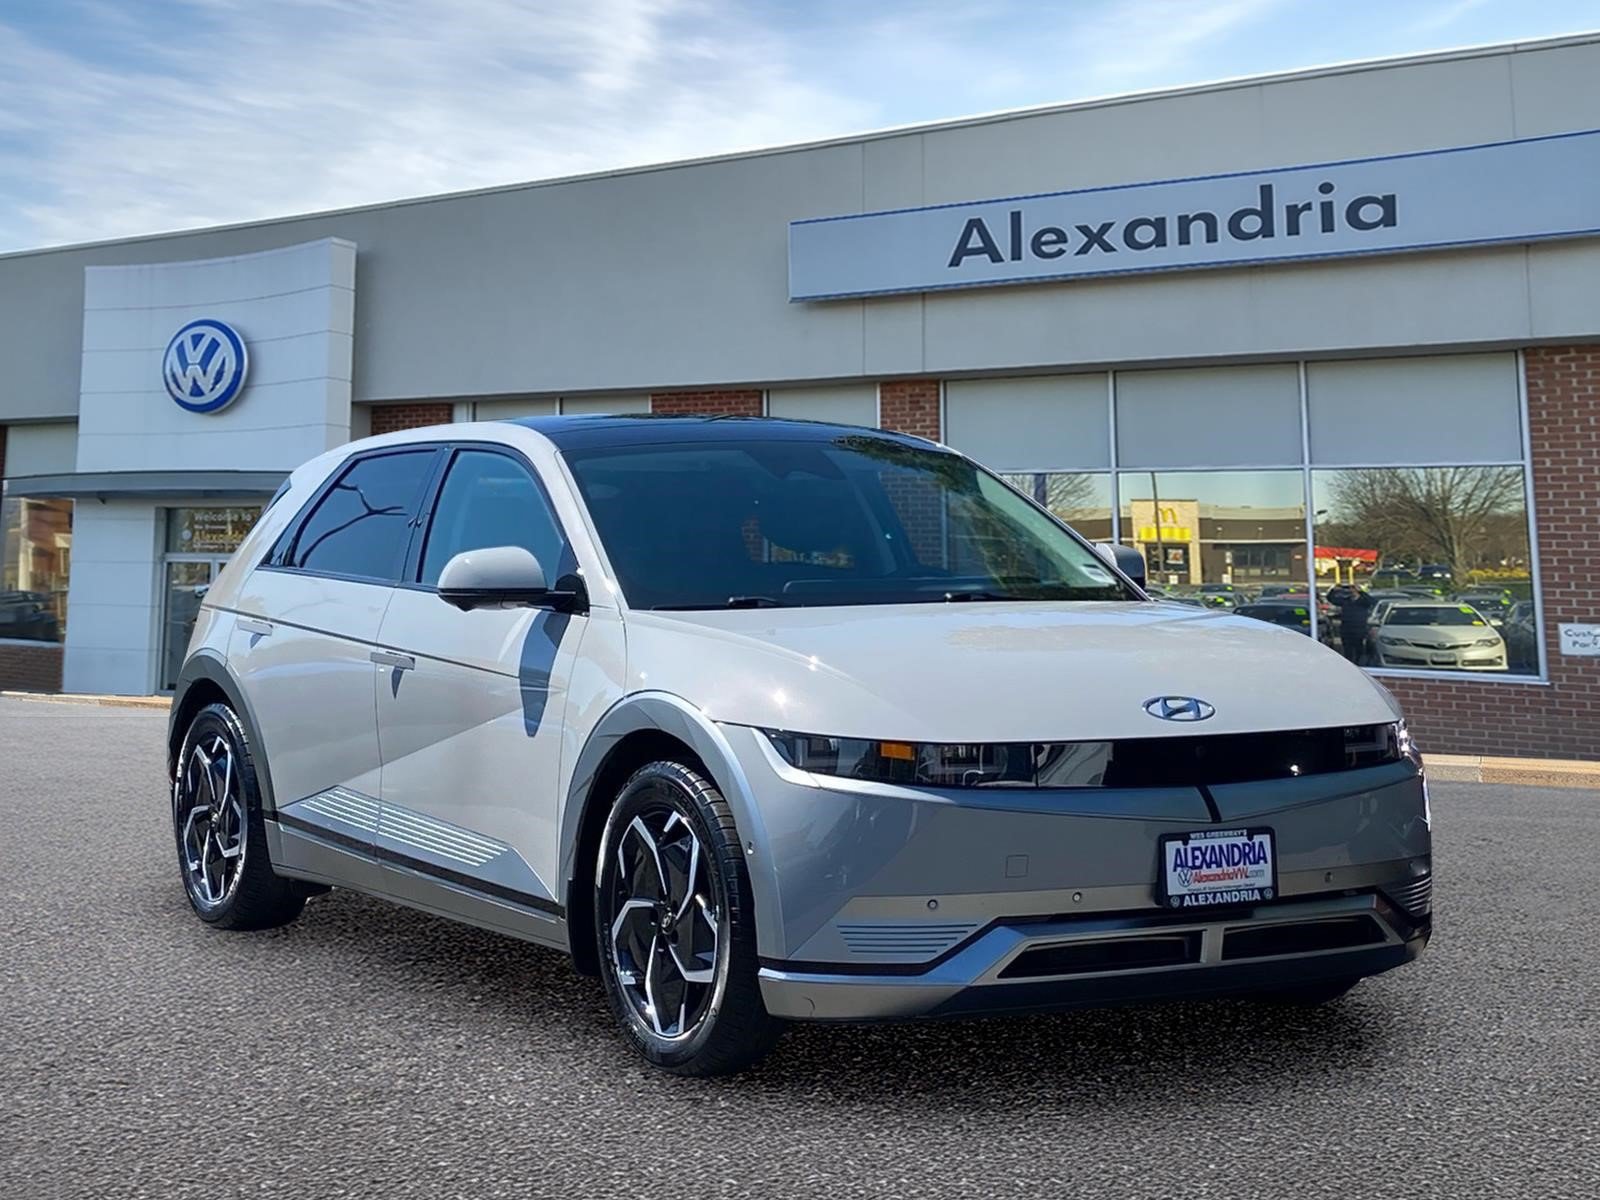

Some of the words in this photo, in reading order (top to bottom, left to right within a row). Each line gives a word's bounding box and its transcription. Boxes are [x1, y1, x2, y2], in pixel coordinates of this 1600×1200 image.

[946, 182, 1398, 268] Alexandria
[1173, 840, 1268, 872] ALEXANDRIA
[1183, 889, 1261, 907] ALEXANDRIA
